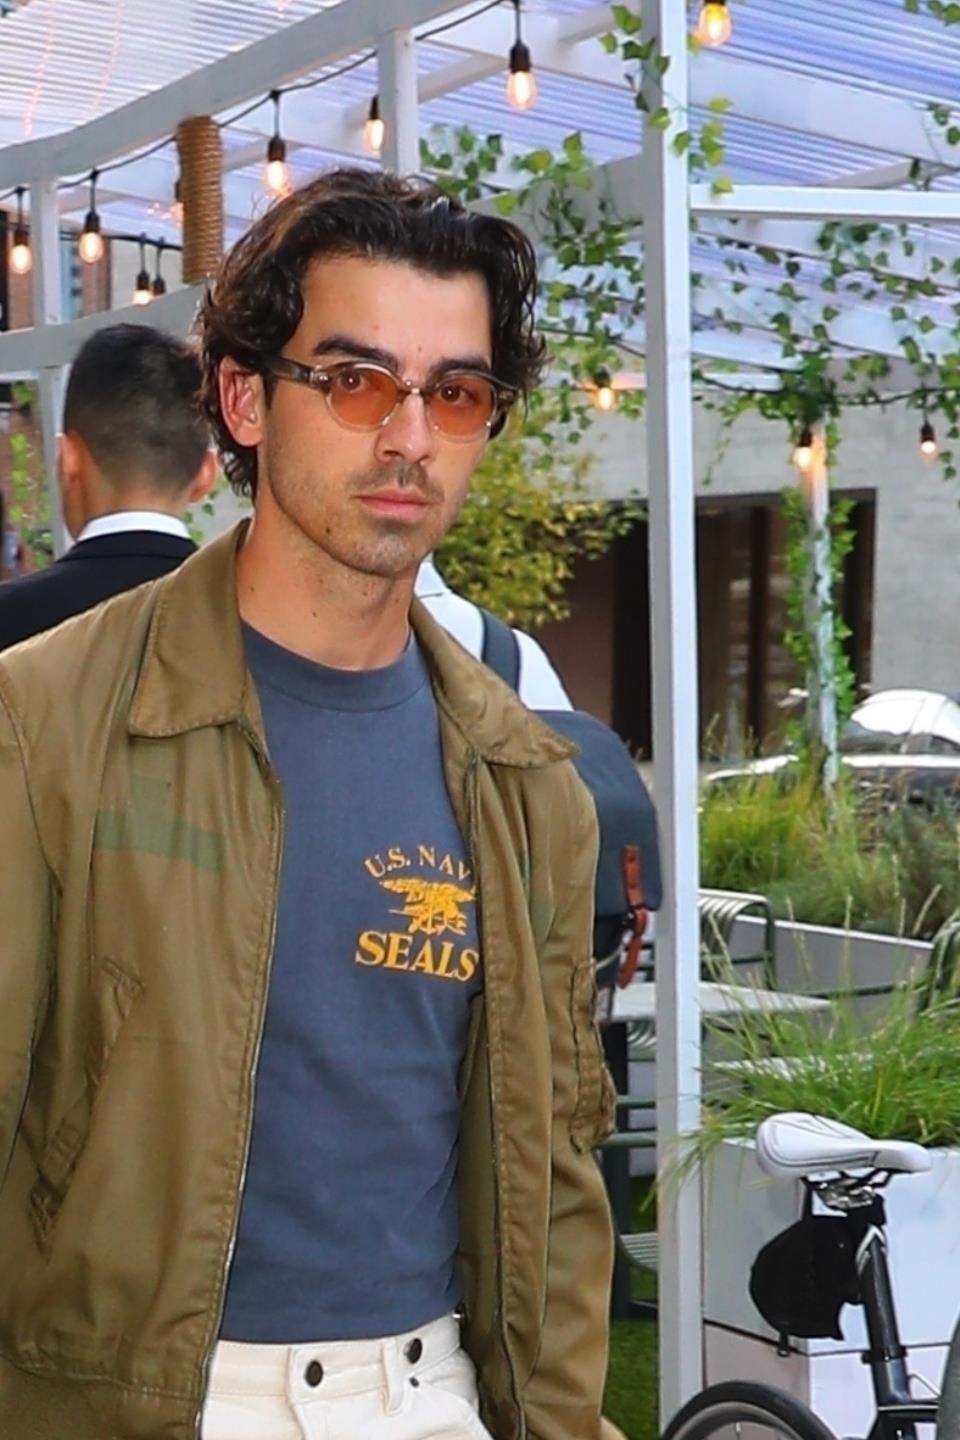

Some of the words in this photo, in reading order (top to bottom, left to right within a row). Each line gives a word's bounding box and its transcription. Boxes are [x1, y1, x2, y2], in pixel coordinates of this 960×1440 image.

[364, 847, 412, 878] U.S.
[418, 845, 476, 886] NAV
[354, 930, 480, 982] SEALS
